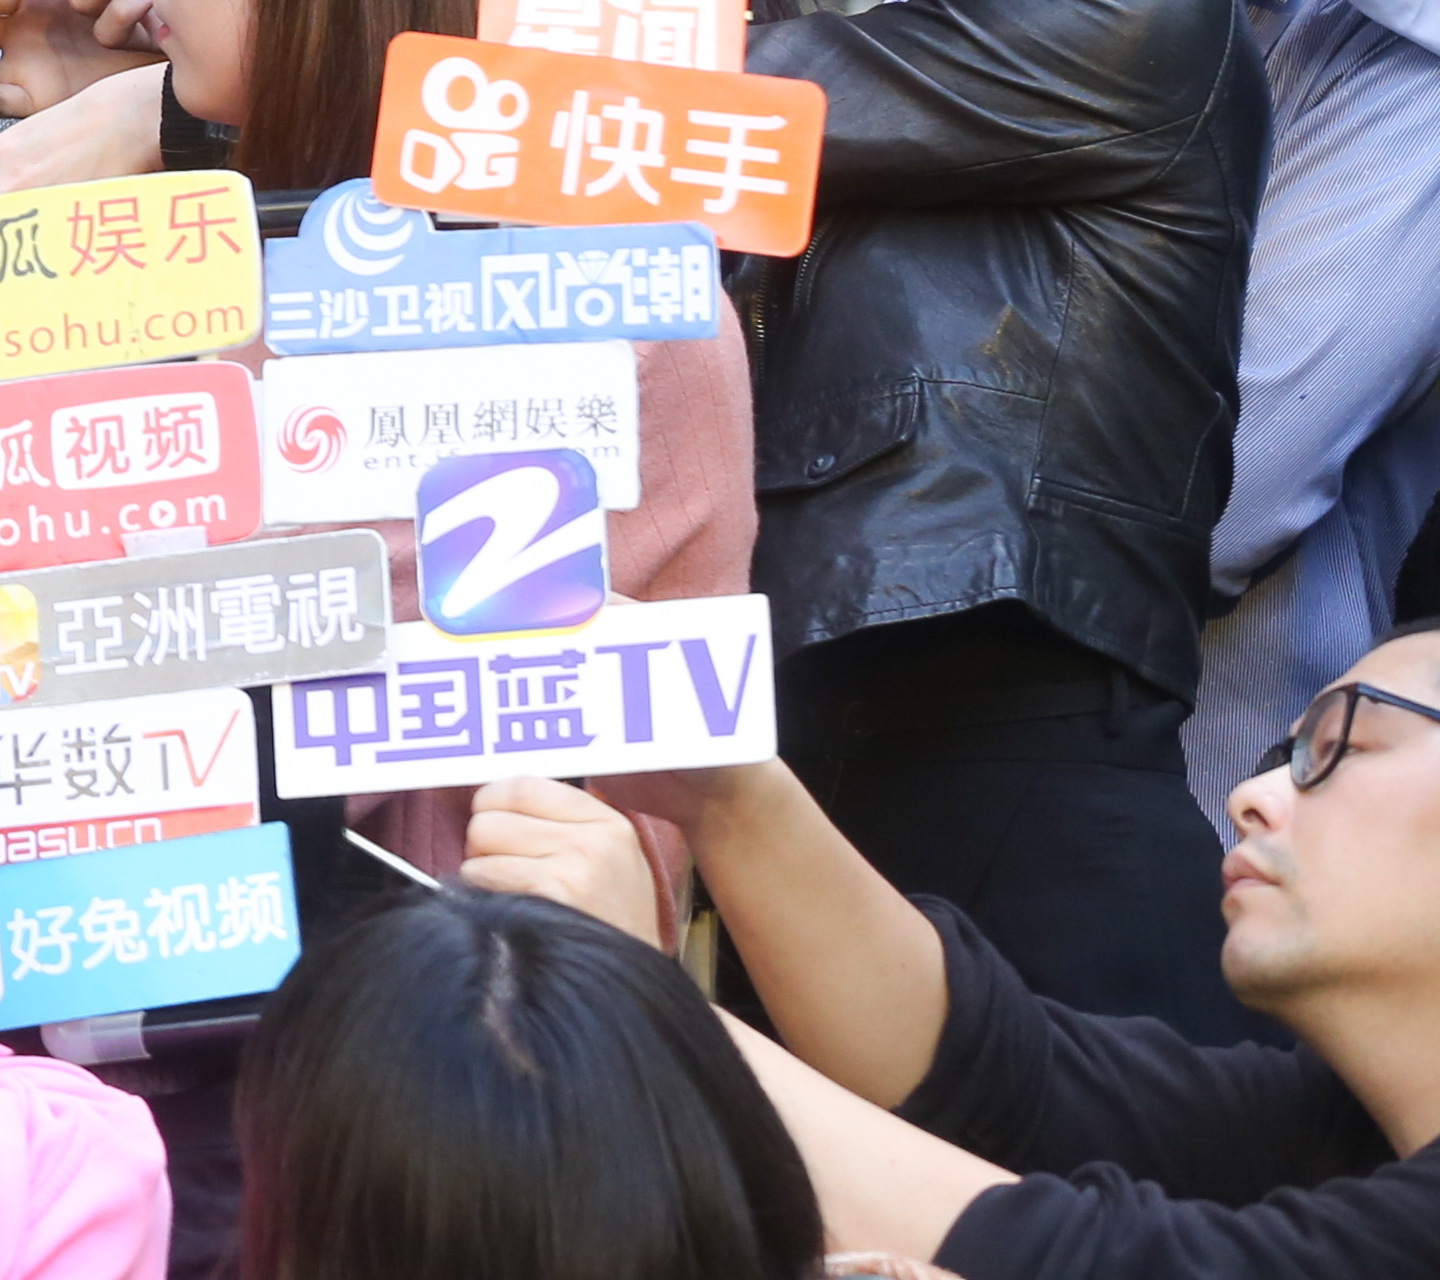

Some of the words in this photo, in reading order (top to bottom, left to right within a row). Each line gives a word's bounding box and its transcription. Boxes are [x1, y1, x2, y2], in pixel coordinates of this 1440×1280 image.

[550, 89, 789, 214] 快手
[267, 281, 477, 341] 三沙卫视
[52, 566, 364, 675] 亞洲電視
[292, 634, 757, 767] 中国蓝TV
[7, 872, 288, 981] 好兔视频
